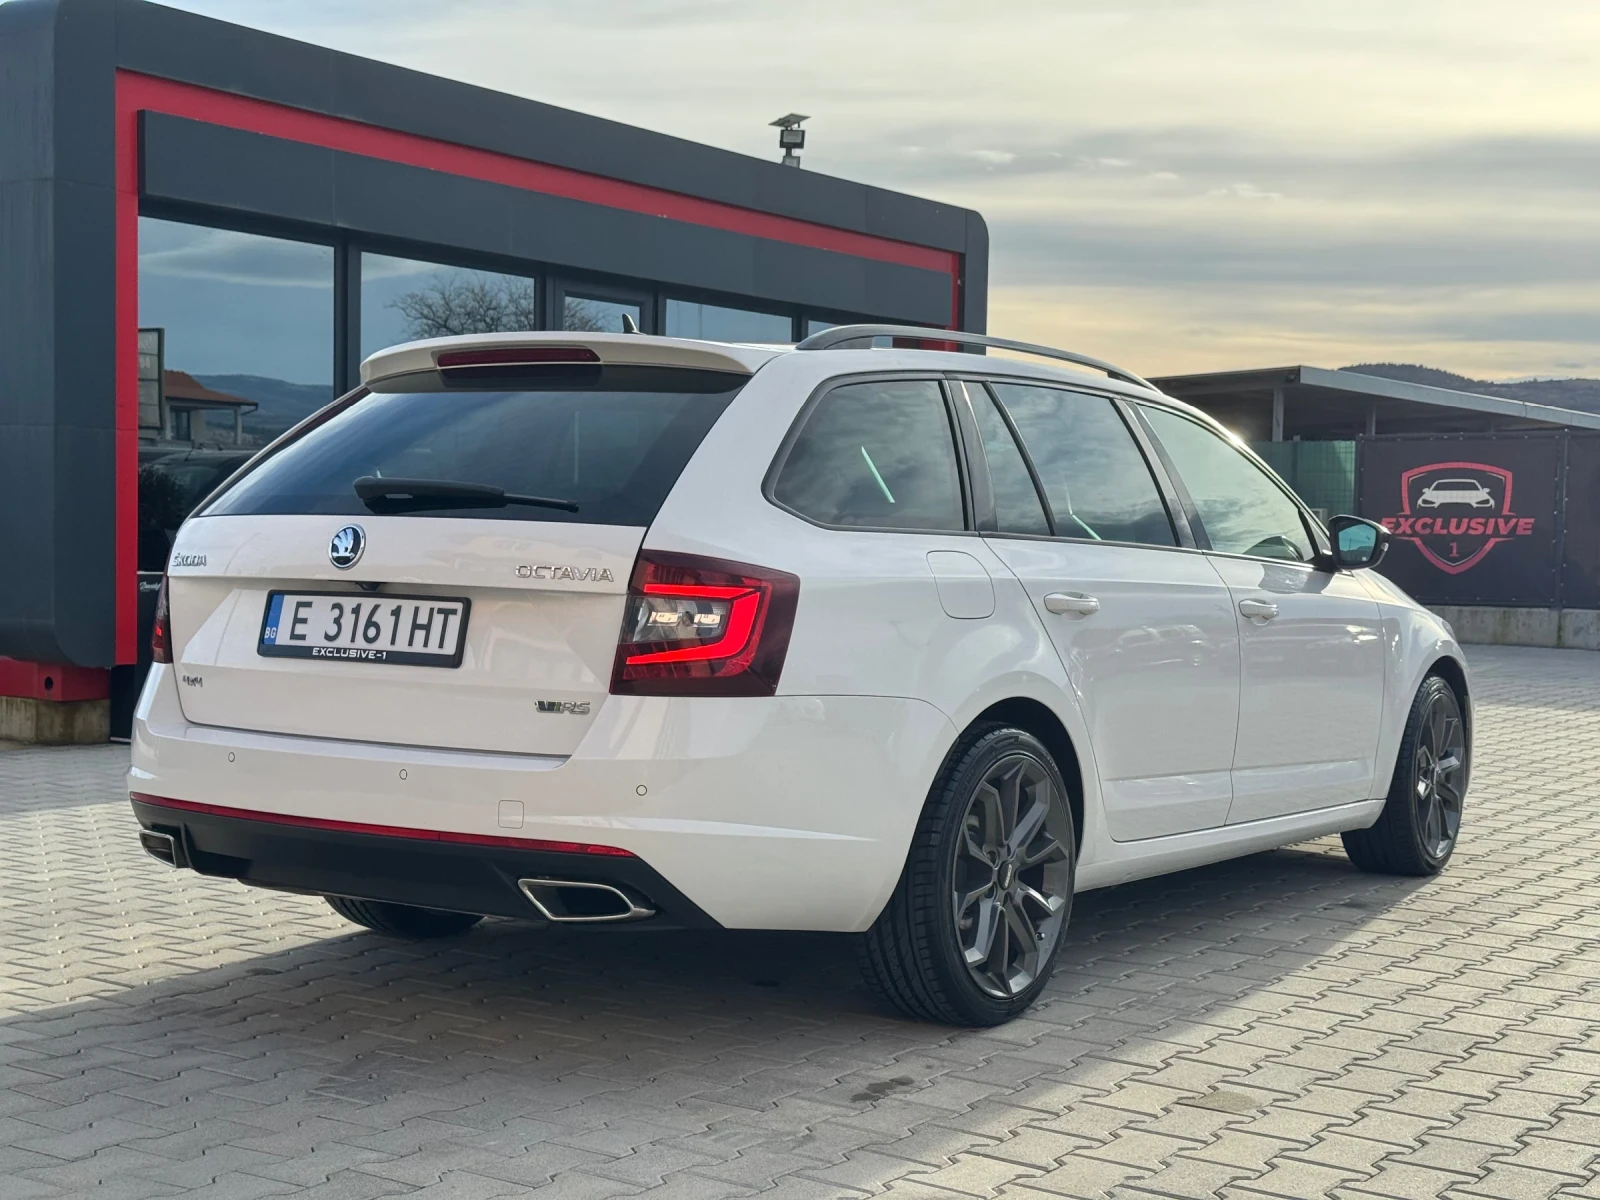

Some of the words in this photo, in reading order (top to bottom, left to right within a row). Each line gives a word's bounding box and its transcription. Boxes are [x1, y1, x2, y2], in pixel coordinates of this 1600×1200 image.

[1381, 517, 1535, 535] EXCLUSIVE
[1449, 541, 1460, 558] 1
[515, 564, 614, 582] OCTAVIA
[289, 601, 313, 641] E
[264, 626, 277, 640] BG
[312, 647, 387, 661] EXCLUSIVE-1
